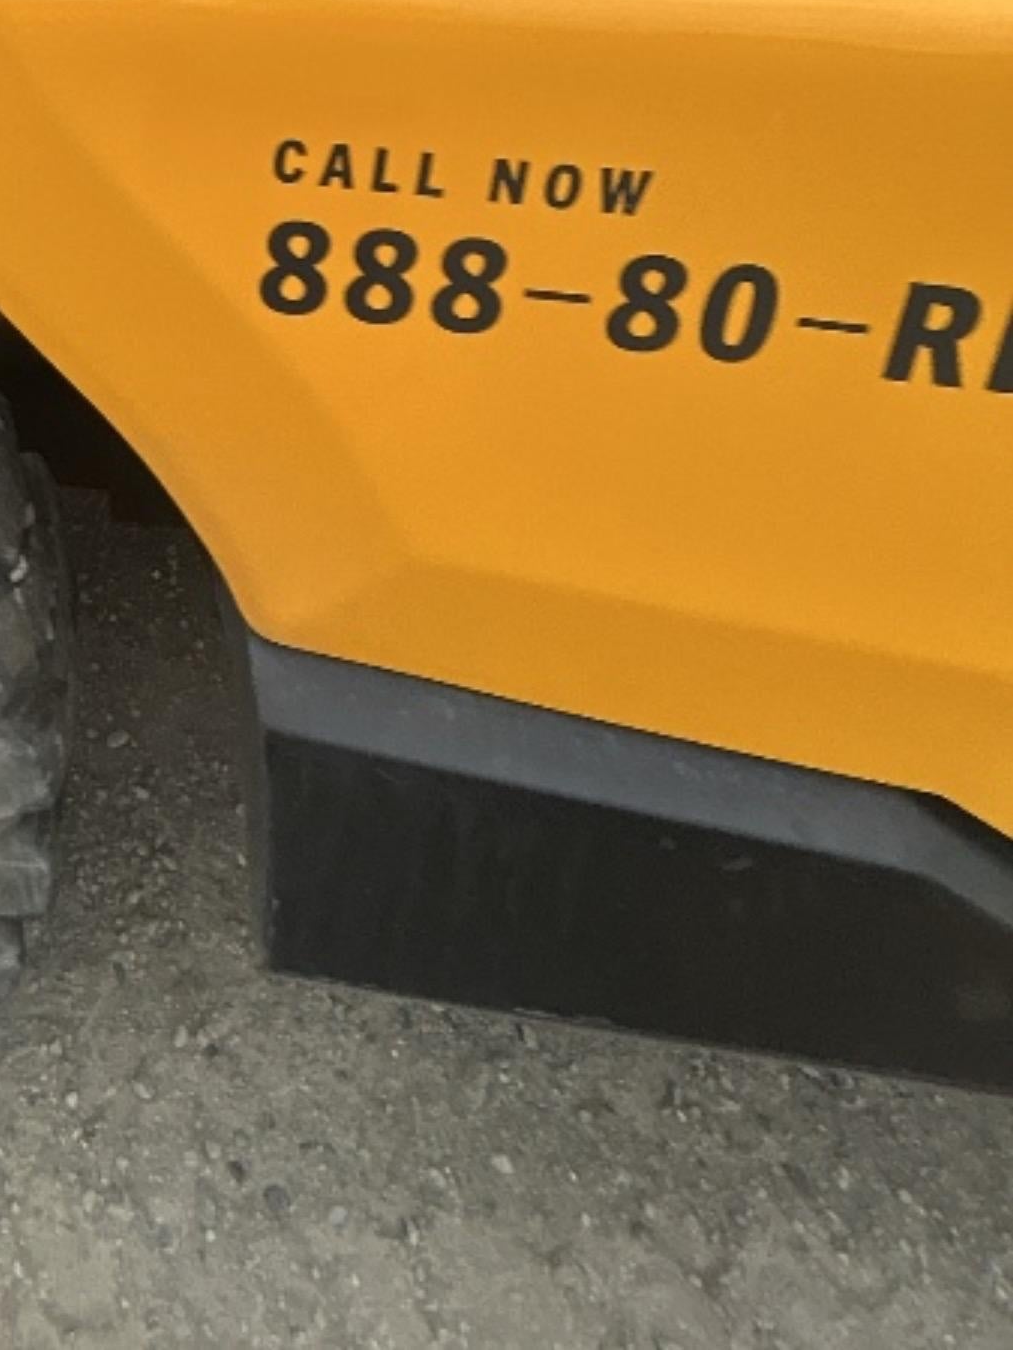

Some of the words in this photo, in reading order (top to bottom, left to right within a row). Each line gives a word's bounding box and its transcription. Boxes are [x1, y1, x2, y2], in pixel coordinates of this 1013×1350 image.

[274, 140, 445, 198] CALL
[488, 159, 653, 216] NOW
[259, 220, 1013, 394] 888-80-R
